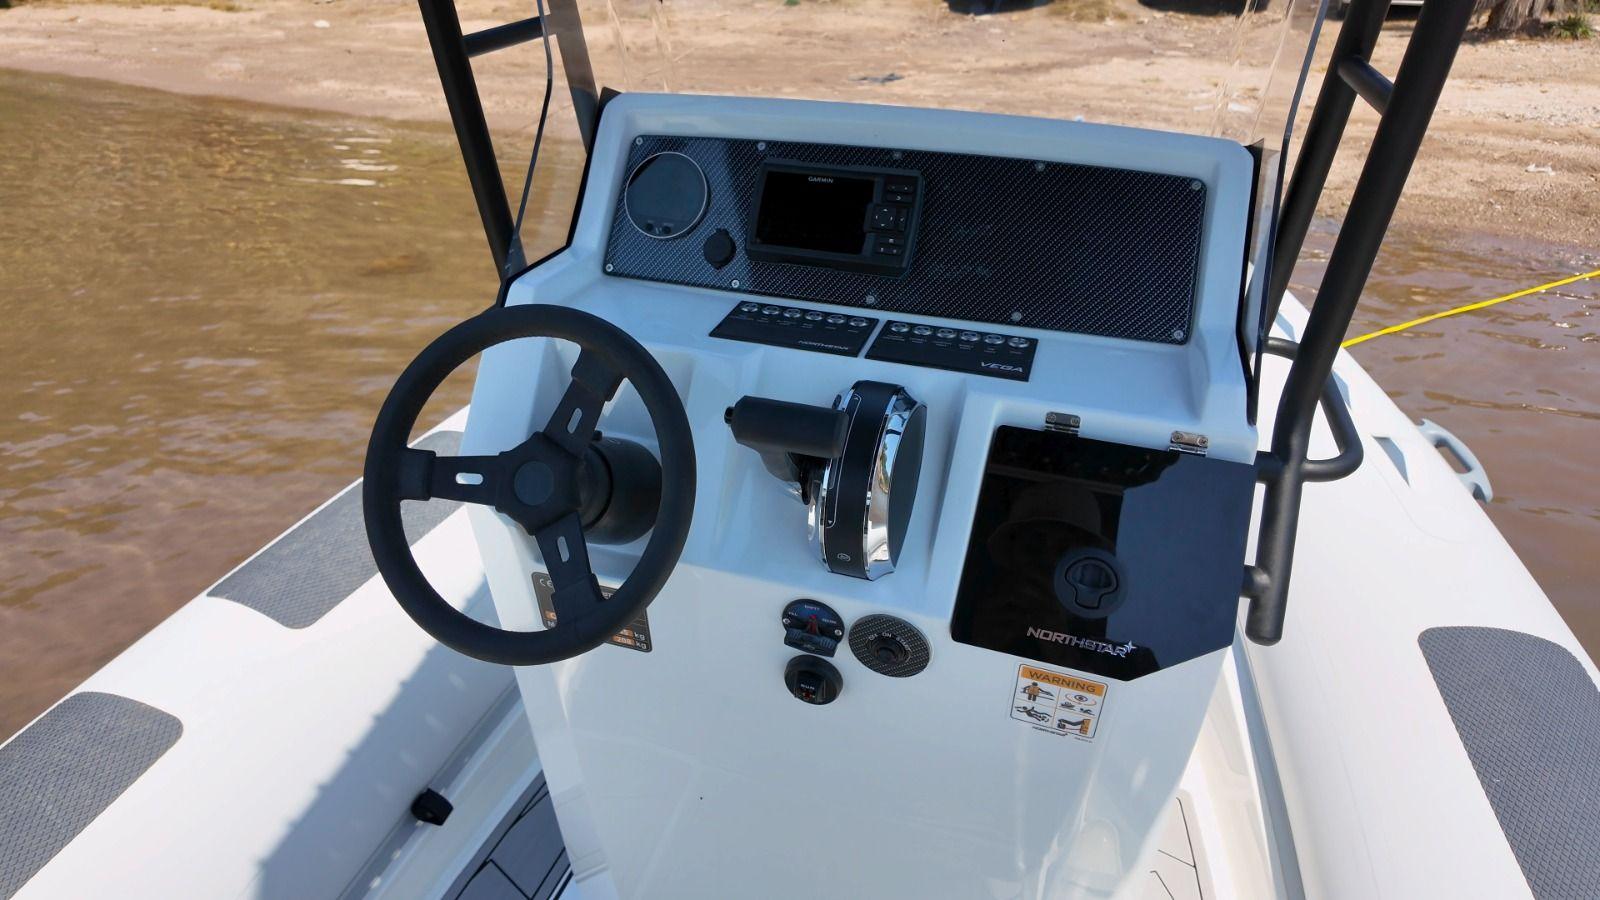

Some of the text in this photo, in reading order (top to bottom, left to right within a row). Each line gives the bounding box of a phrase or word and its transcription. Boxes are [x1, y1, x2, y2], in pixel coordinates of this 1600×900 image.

[980, 360, 1024, 373] VEGA
[1026, 626, 1128, 658] NORTHSTAR
[1028, 670, 1097, 693] WARNING
